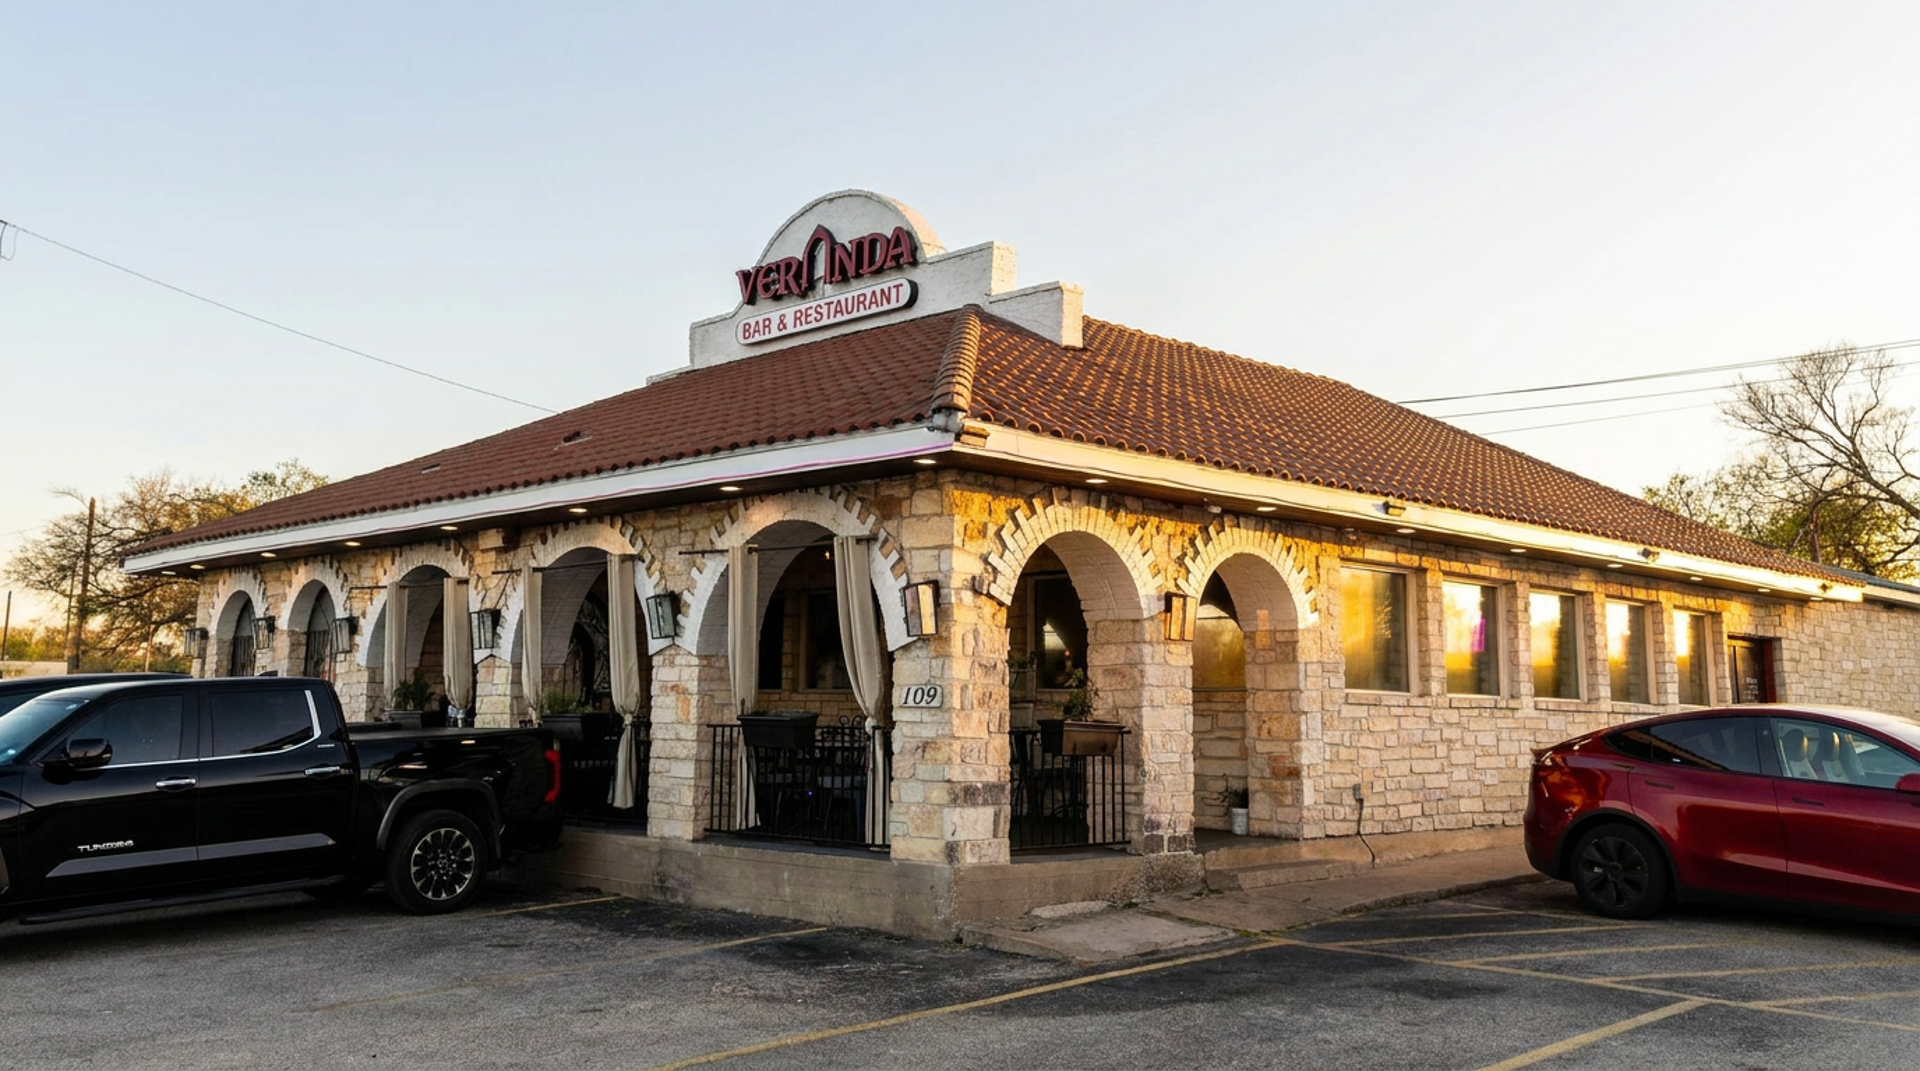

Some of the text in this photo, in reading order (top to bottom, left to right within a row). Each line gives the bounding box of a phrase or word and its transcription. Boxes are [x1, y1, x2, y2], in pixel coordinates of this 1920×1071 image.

[735, 224, 916, 305] VERANDA
[742, 283, 903, 340] BAR & RESTAURANT
[902, 686, 938, 705] 109
